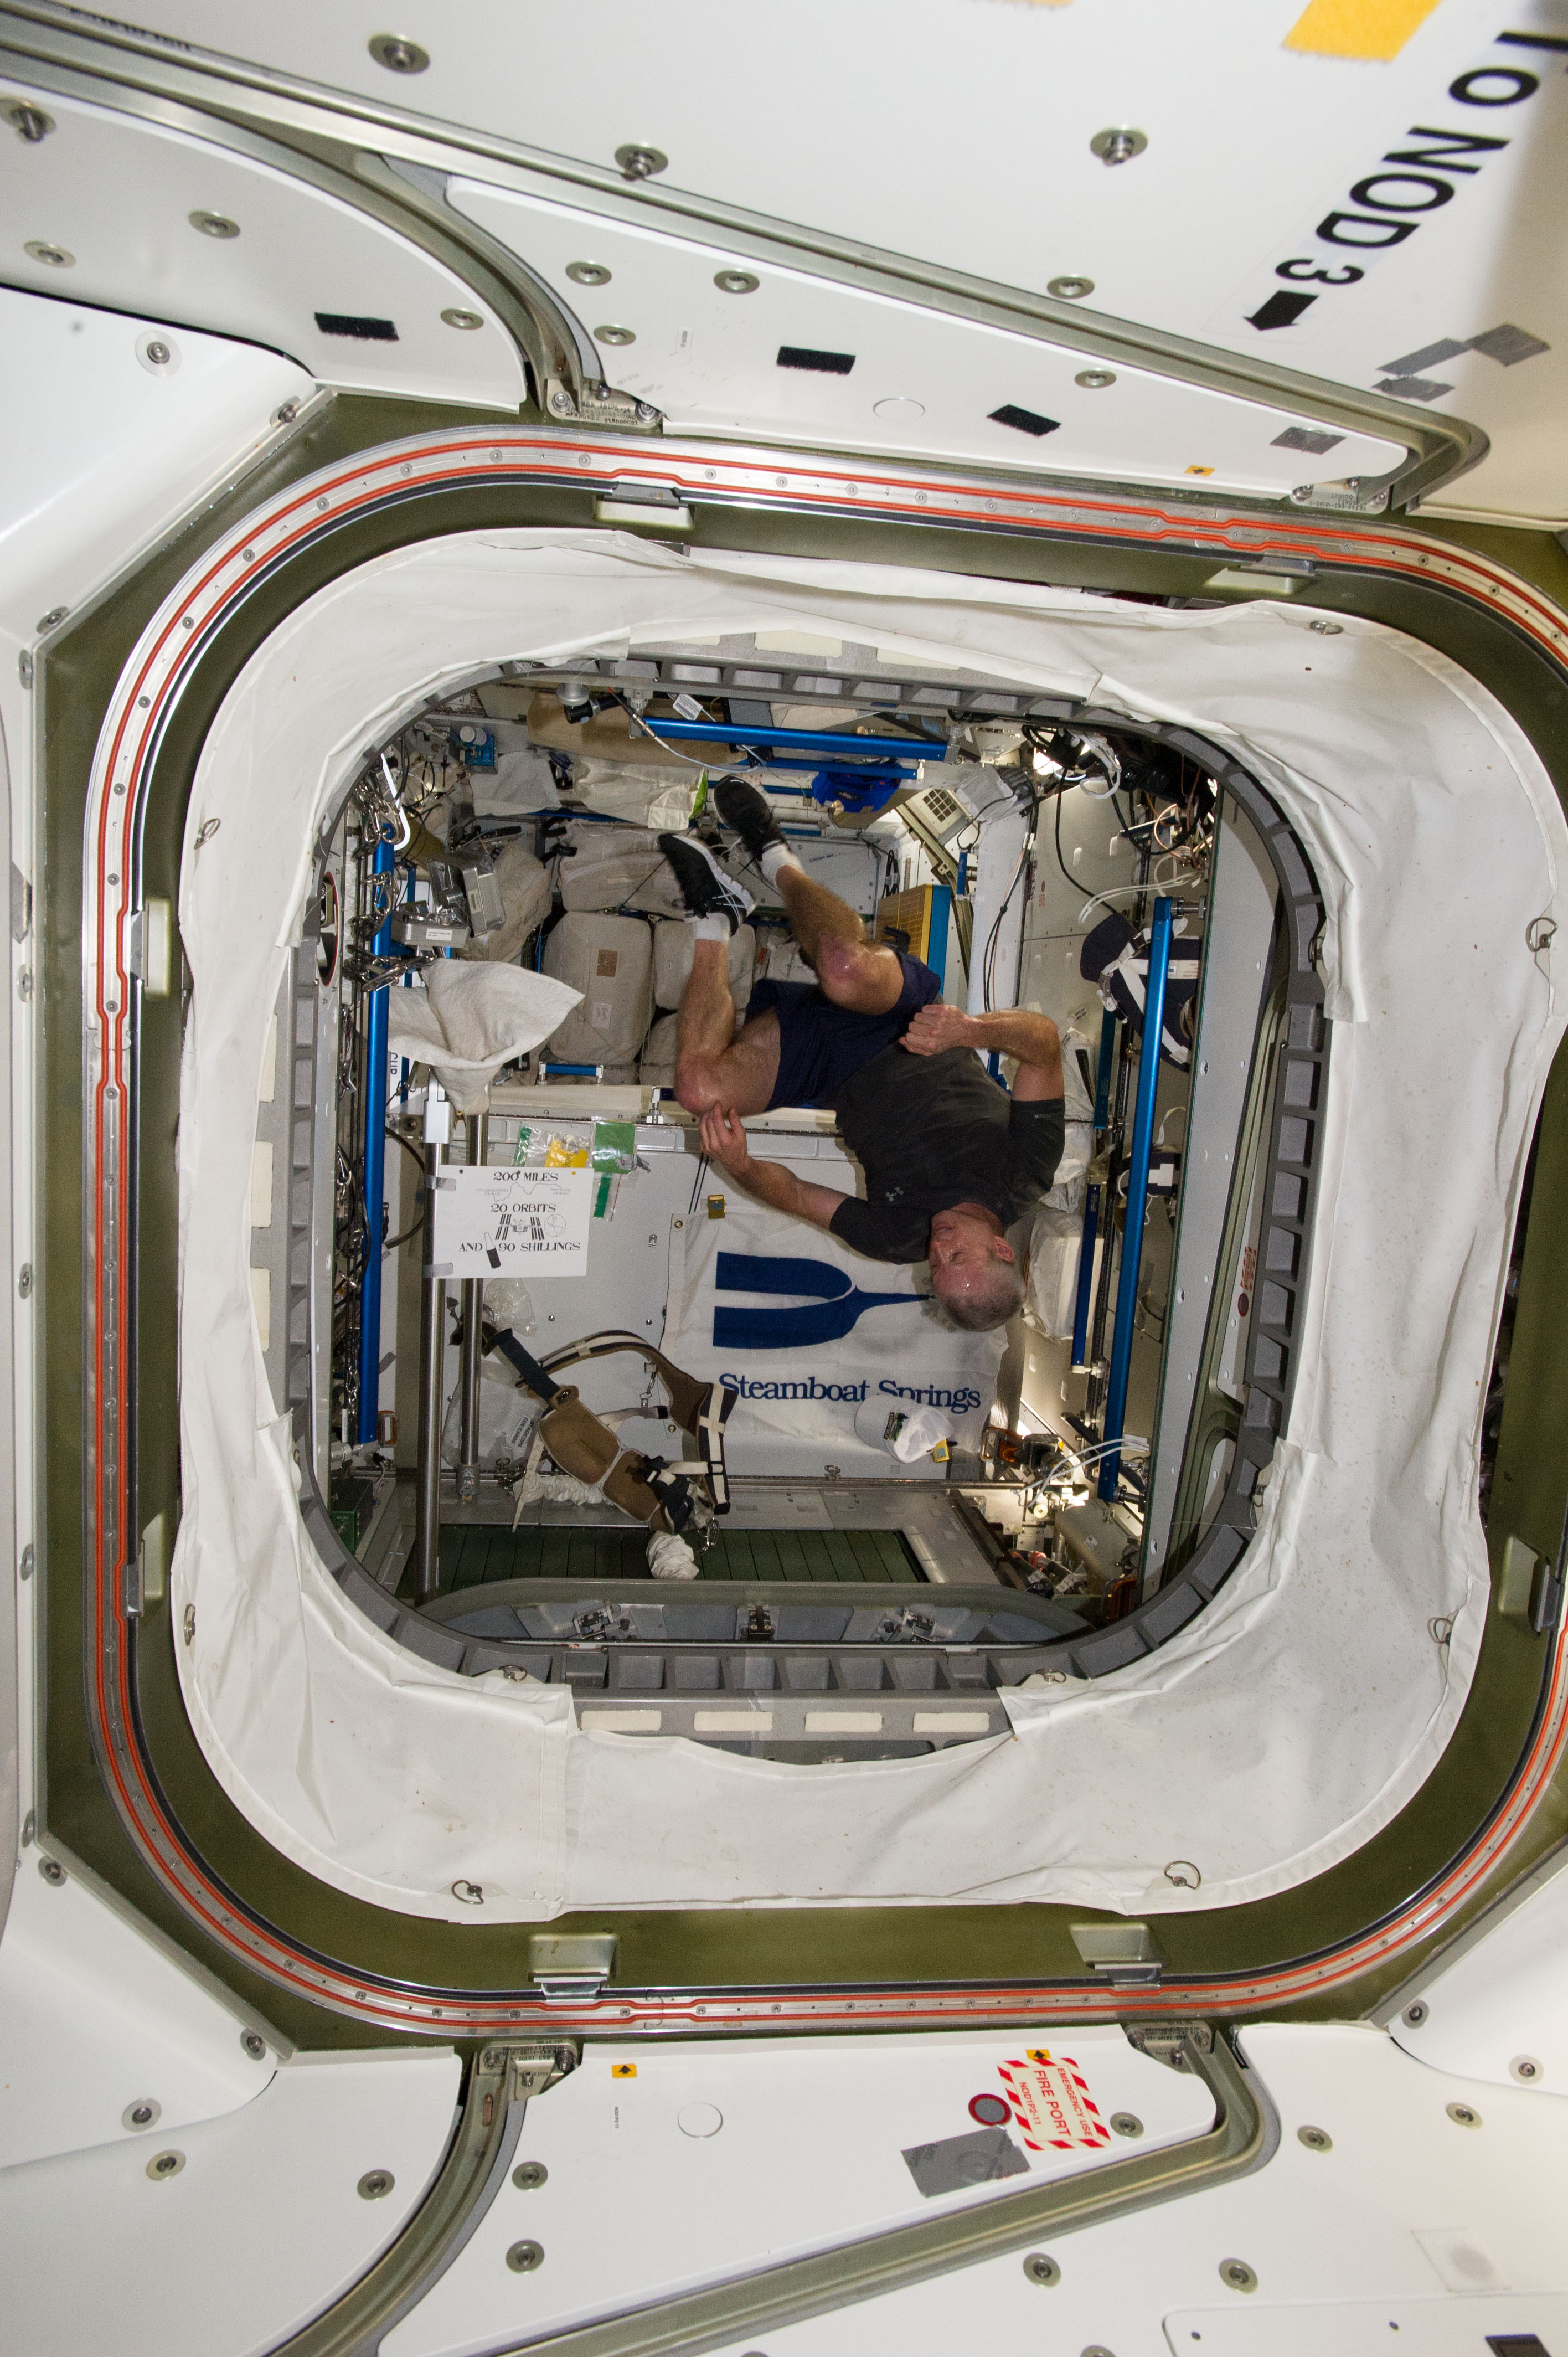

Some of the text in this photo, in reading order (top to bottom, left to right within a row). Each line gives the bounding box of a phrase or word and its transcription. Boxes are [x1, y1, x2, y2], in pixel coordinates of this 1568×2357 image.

[494, 1172, 558, 1181] 200 MILES
[491, 1203, 556, 1213] 20 ORBITS
[459, 1242, 581, 1252] AND 90 SHILLINGS
[719, 1373, 870, 1402] Steamboat
[511, 1427, 522, 1444] CARDS
[1019, 2082, 1042, 2125] NOD1P2-11
[1033, 2070, 1071, 2136] FIRE PORT
[1057, 2068, 1093, 2137] EMERGENCY USE
